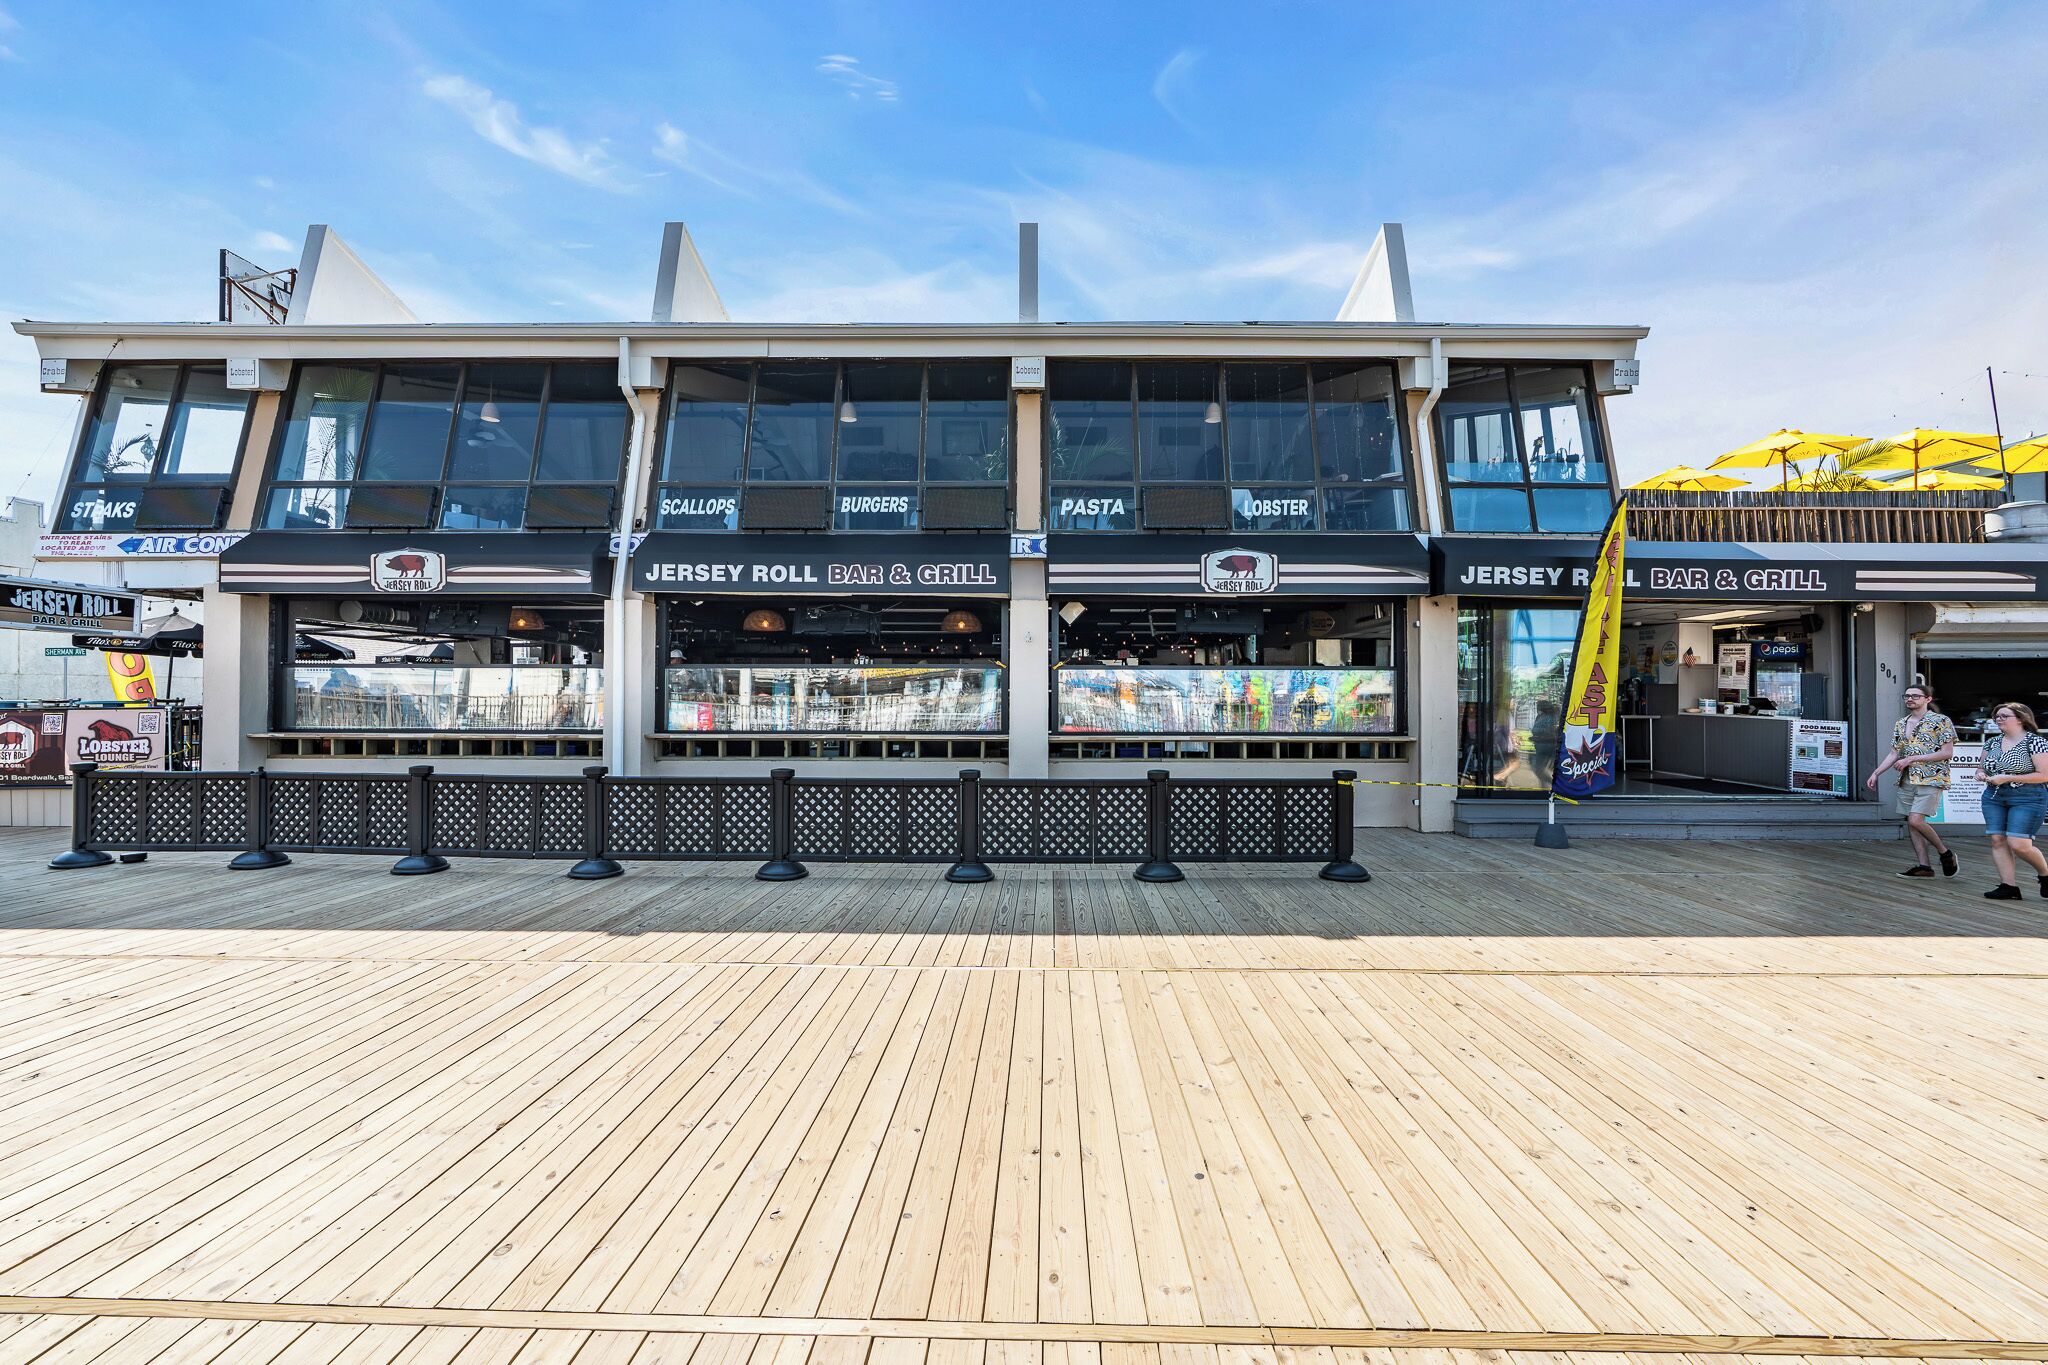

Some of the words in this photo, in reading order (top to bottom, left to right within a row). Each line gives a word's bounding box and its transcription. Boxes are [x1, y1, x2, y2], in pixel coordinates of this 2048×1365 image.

[42, 367, 66, 375] Crabs
[230, 367, 254, 376] Lobster
[1015, 365, 1040, 375] Lobster
[1614, 368, 1639, 377] Crabs
[660, 498, 736, 515] SCALLOPS
[840, 496, 909, 513] BURGERS
[1060, 498, 1126, 516] PASTA
[1244, 499, 1309, 516] LOBSTER
[137, 536, 178, 553] AIR
[1010, 537, 1034, 554] IR
[646, 564, 744, 582] JERSEY
[752, 564, 818, 582] ROLL
[827, 564, 884, 584] BAR
[889, 564, 912, 585] &
[917, 564, 997, 585] GRILL
[1460, 566, 1562, 585] JERSEY
[1572, 567, 1641, 587] RL
[1650, 568, 1710, 589] BAR
[1714, 569, 1738, 590] &
[1743, 569, 1827, 590] GRILL
[384, 580, 411, 591] JERSEY
[414, 580, 432, 590] ROLL
[1214, 581, 1242, 591] JERSEY
[1245, 581, 1264, 591] ROLL
[10, 588, 78, 617] JERSEY
[81, 593, 122, 617] ROLL
[31, 614, 56, 625] BAR
[59, 616, 68, 625] &
[71, 618, 104, 628] GRILL
[45, 648, 74, 656] SHERMAN
[172, 640, 196, 649] Tito's
[1772, 644, 1799, 655] pepsi
[1880, 662, 1897, 684] 901
[80, 738, 151, 755] LOBSTER
[1, 751, 11, 760] SEY
[13, 751, 27, 760] ROLL
[95, 753, 135, 762] LOUNGE
[1561, 749, 1609, 779] Special
